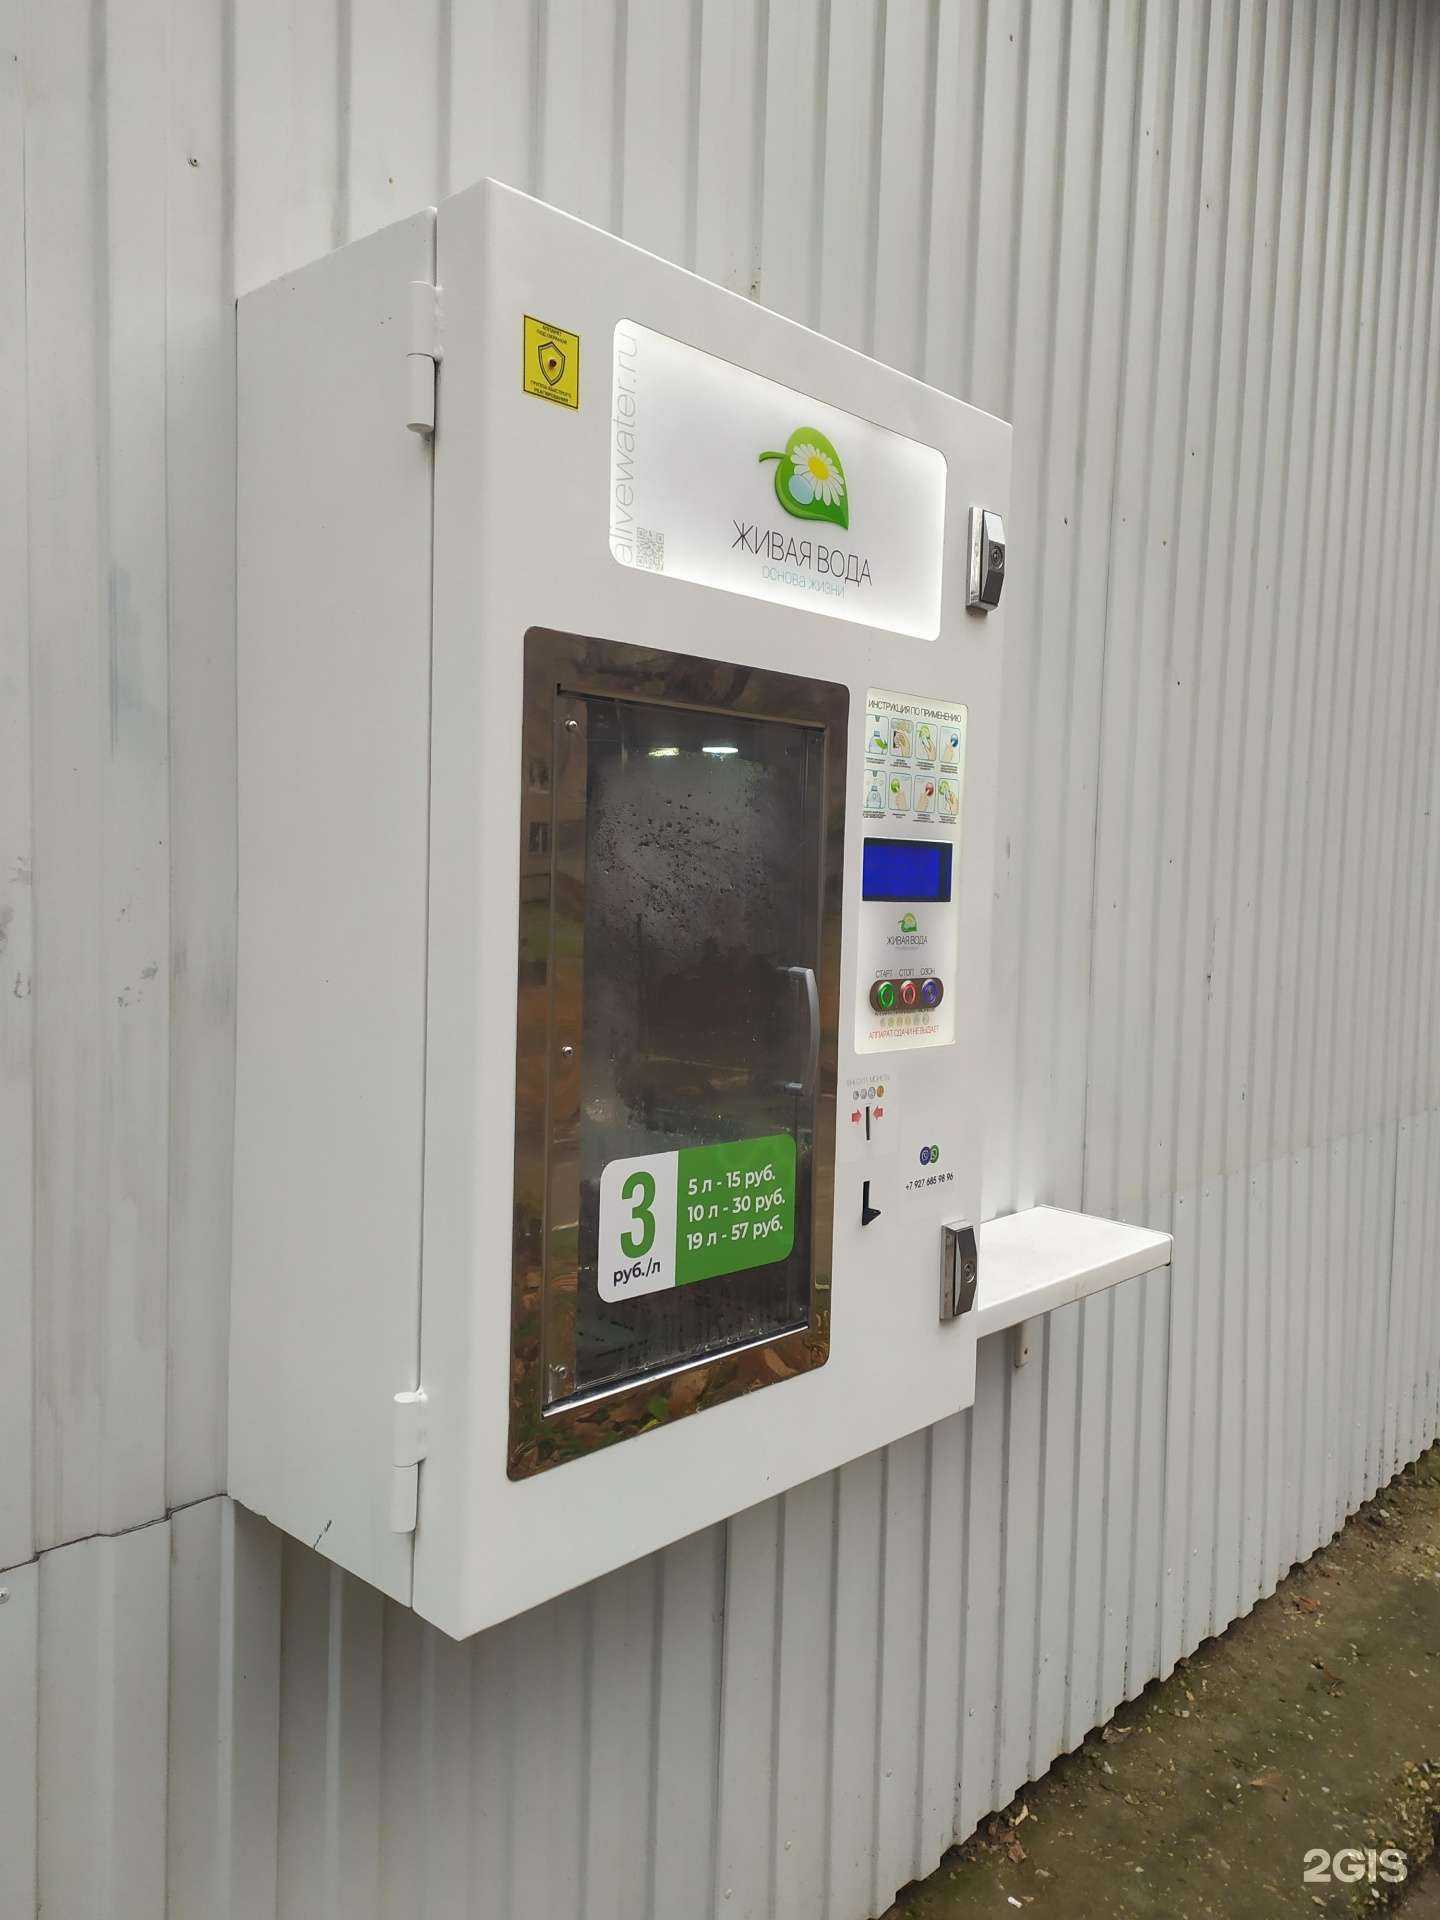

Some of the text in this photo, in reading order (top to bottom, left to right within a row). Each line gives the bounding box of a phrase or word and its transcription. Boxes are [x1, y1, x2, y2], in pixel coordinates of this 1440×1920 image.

[609, 332, 639, 565] alivewater.ru
[731, 519, 873, 588] ЖИВАЯ ВОДА
[808, 579, 846, 599] жизни
[868, 699, 962, 723] ИНСТРУКЦИЯ ПО ПРИМЕНЕНИЮ
[886, 935, 928, 946] ЖИВАЯ ВОДА
[875, 968, 894, 979] СТАРТ
[898, 967, 915, 977] СТОП
[920, 966, 937, 976] ОЗОН
[687, 1178, 698, 1196] 5
[701, 1179, 712, 1193] л
[726, 1171, 741, 1188] 15
[745, 1164, 776, 1189] руб.
[905, 1171, 954, 1191] +7 927 685 98 96
[621, 1171, 656, 1258] 3
[687, 1205, 705, 1223] 10
[708, 1204, 718, 1219] л
[732, 1196, 751, 1214] 30
[755, 1187, 785, 1213] руб.
[686, 1232, 703, 1251] 19
[706, 1231, 717, 1247] л
[731, 1222, 749, 1241] 57
[753, 1214, 783, 1240] руб.
[613, 1257, 661, 1287] руб./л
